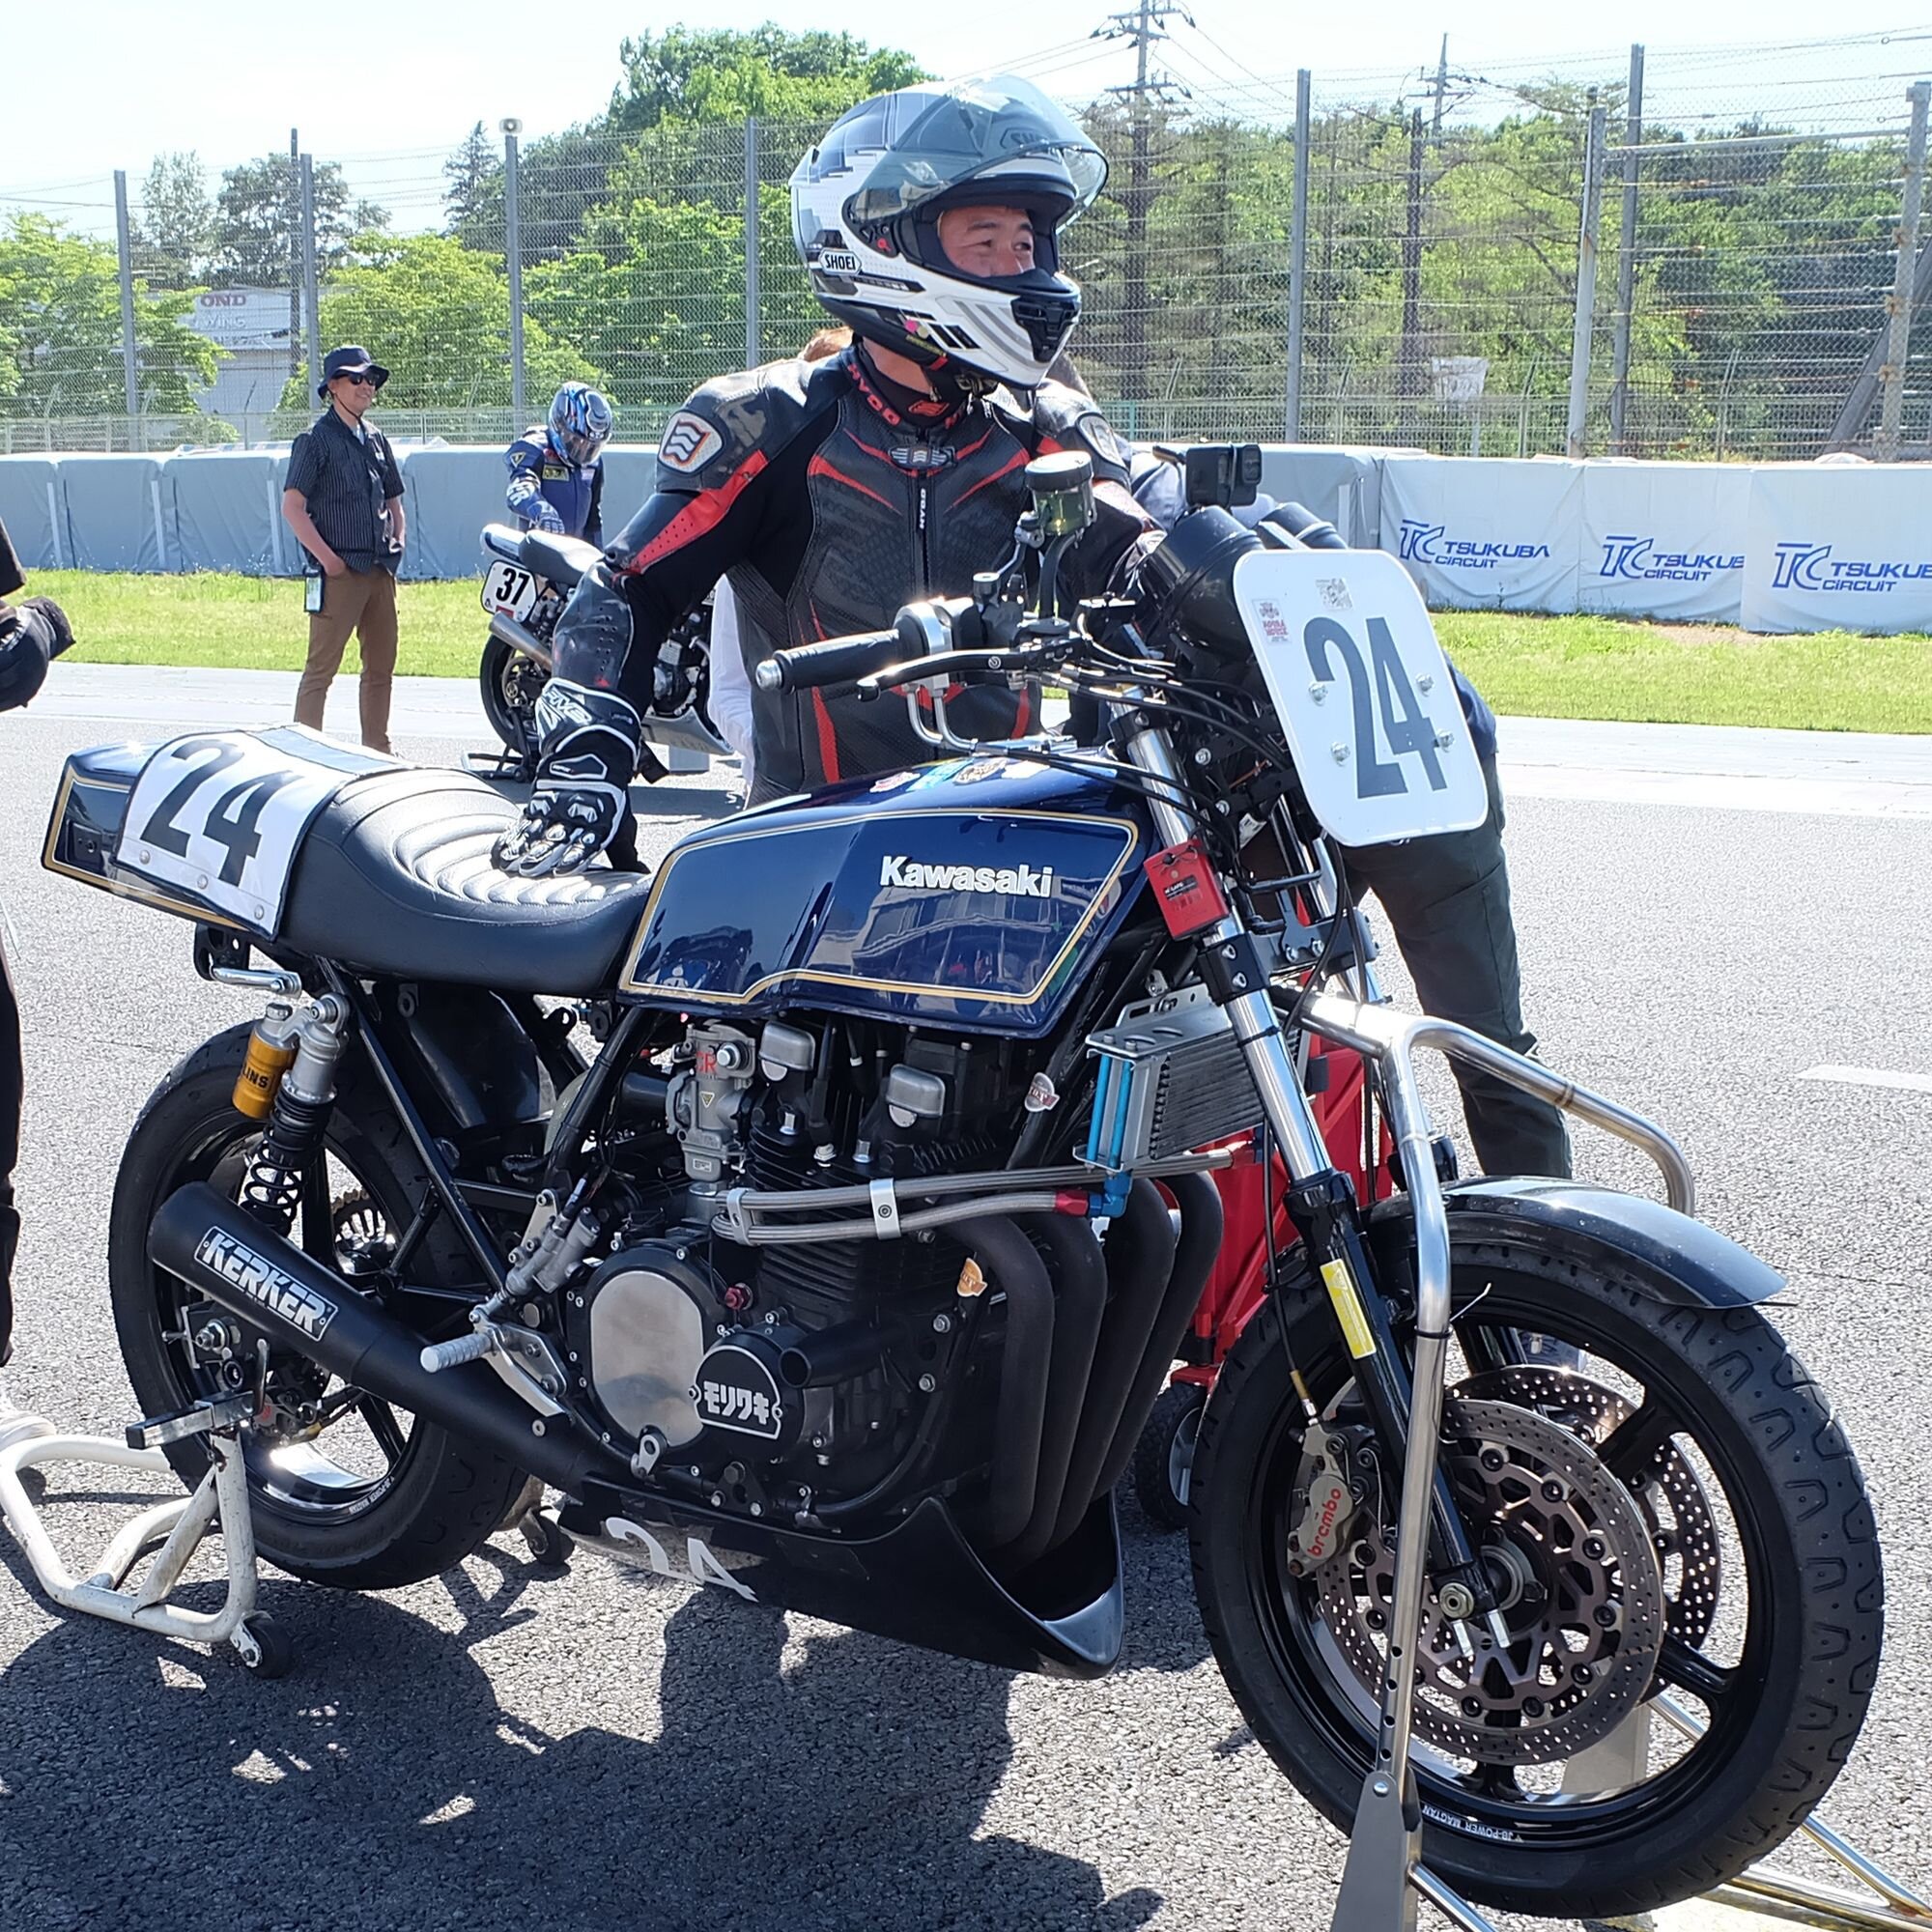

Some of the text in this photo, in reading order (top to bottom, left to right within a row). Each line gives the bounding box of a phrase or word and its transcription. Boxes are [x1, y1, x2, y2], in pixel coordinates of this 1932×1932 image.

[825, 254, 856, 270] SHOEI
[1400, 519, 1446, 564] TC
[1435, 555, 1498, 569] CIRCUIT
[1443, 540, 1550, 558] TSUKUBA
[1600, 535, 1654, 580] TC
[496, 567, 530, 606] 37
[1644, 568, 1712, 582] CIRCUIT
[1772, 542, 1833, 591] TC
[1822, 579, 1897, 592] CIRCUIT
[1303, 616, 1447, 800] 24
[140, 739, 305, 888] 24
[880, 855, 1053, 898] Kawasaki
[202, 1233, 327, 1334] KERKER
[703, 1380, 770, 1425] モリワキ
[1307, 1489, 1342, 1556] brembo
[1464, 1821, 1515, 1842] JB-POWER
